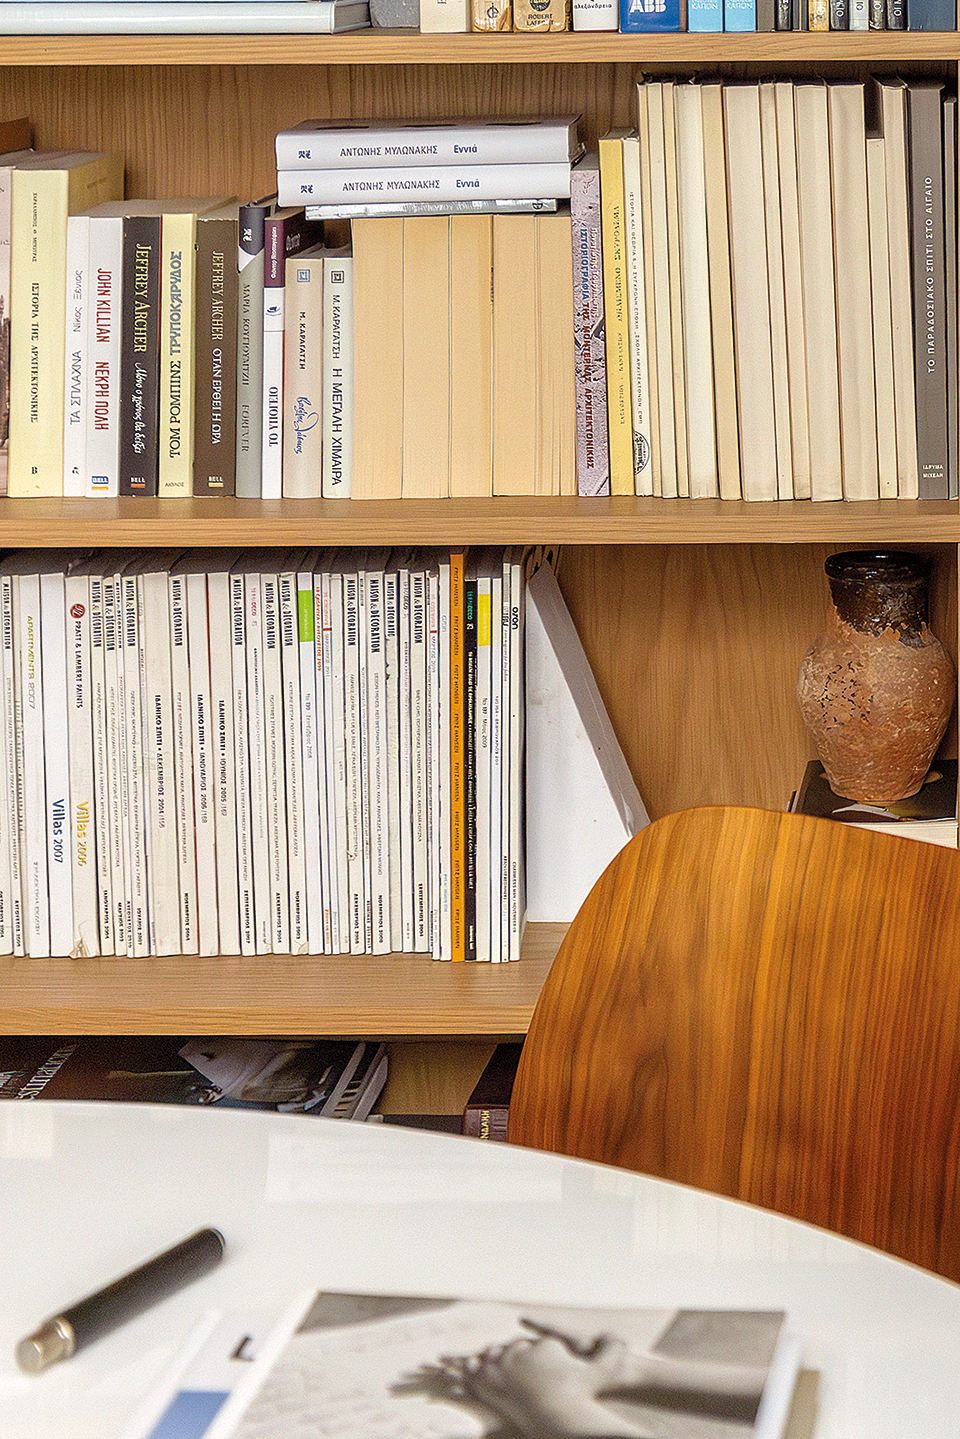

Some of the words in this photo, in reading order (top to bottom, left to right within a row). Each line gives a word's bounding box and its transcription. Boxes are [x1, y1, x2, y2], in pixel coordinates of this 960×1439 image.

[97, 268, 112, 295] JOHN
[135, 243, 151, 297] JEFFREY
[97, 299, 111, 342] KILLIAN
[134, 300, 150, 352] ARCHER
[95, 361, 109, 397] ΝΕΚΡΗ
[333, 368, 342, 377] Η
[169, 360, 181, 424] ΡΟΜΠΙΝΣ
[269, 387, 278, 430] ΥΠΟΓΕΙΟ
[332, 382, 342, 432] ΜΕΓΑΛΗ
[95, 401, 109, 430] ΠΟΛΗ
[169, 427, 181, 458] ΤΟΜ
[269, 433, 278, 447] ΤΟ
[331, 437, 342, 486] ΧΙΜΑΙΡΑ
[52, 799, 65, 835] Villas
[75, 801, 89, 839] Villas
[53, 837, 64, 864] 2007
[77, 841, 88, 867] 2006
